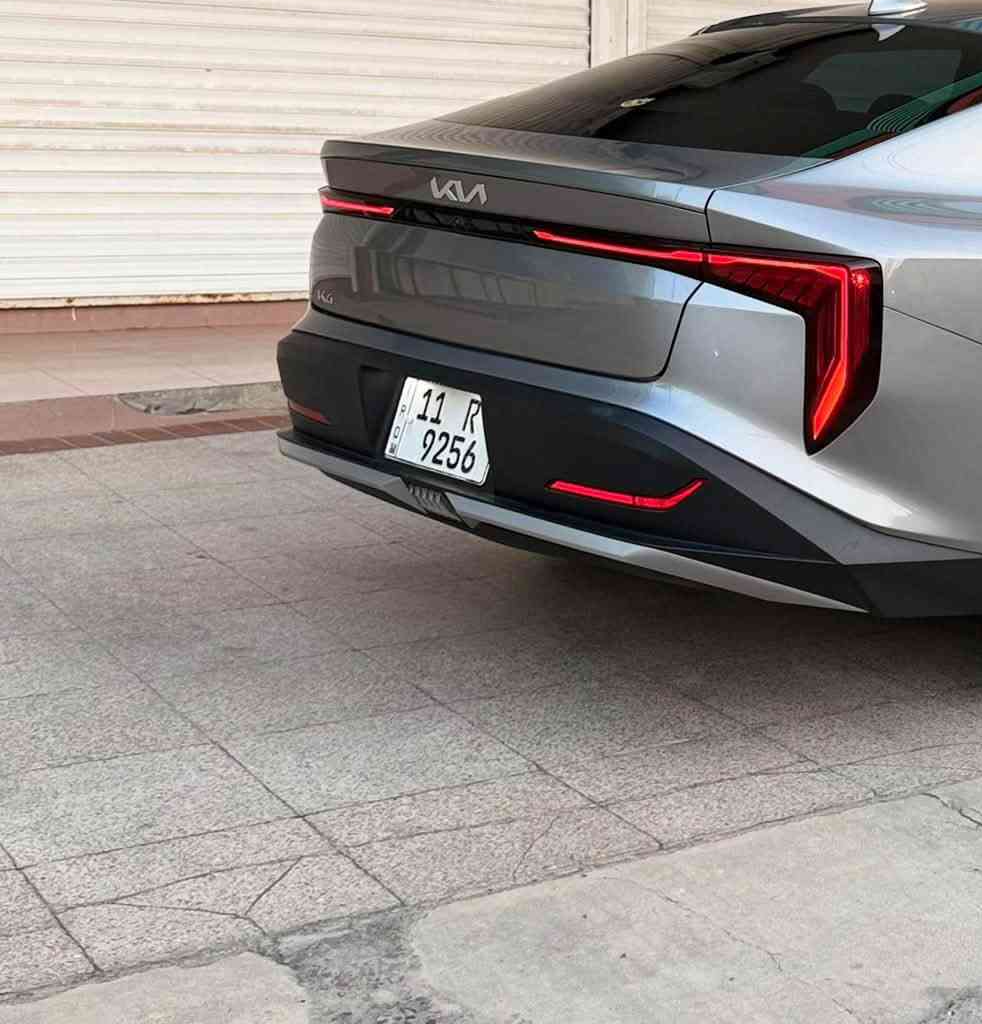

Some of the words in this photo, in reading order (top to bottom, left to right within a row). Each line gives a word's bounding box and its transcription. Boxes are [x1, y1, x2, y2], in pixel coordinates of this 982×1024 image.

[416, 388, 446, 425] 11
[462, 398, 482, 434] R
[420, 428, 477, 474] 9256
